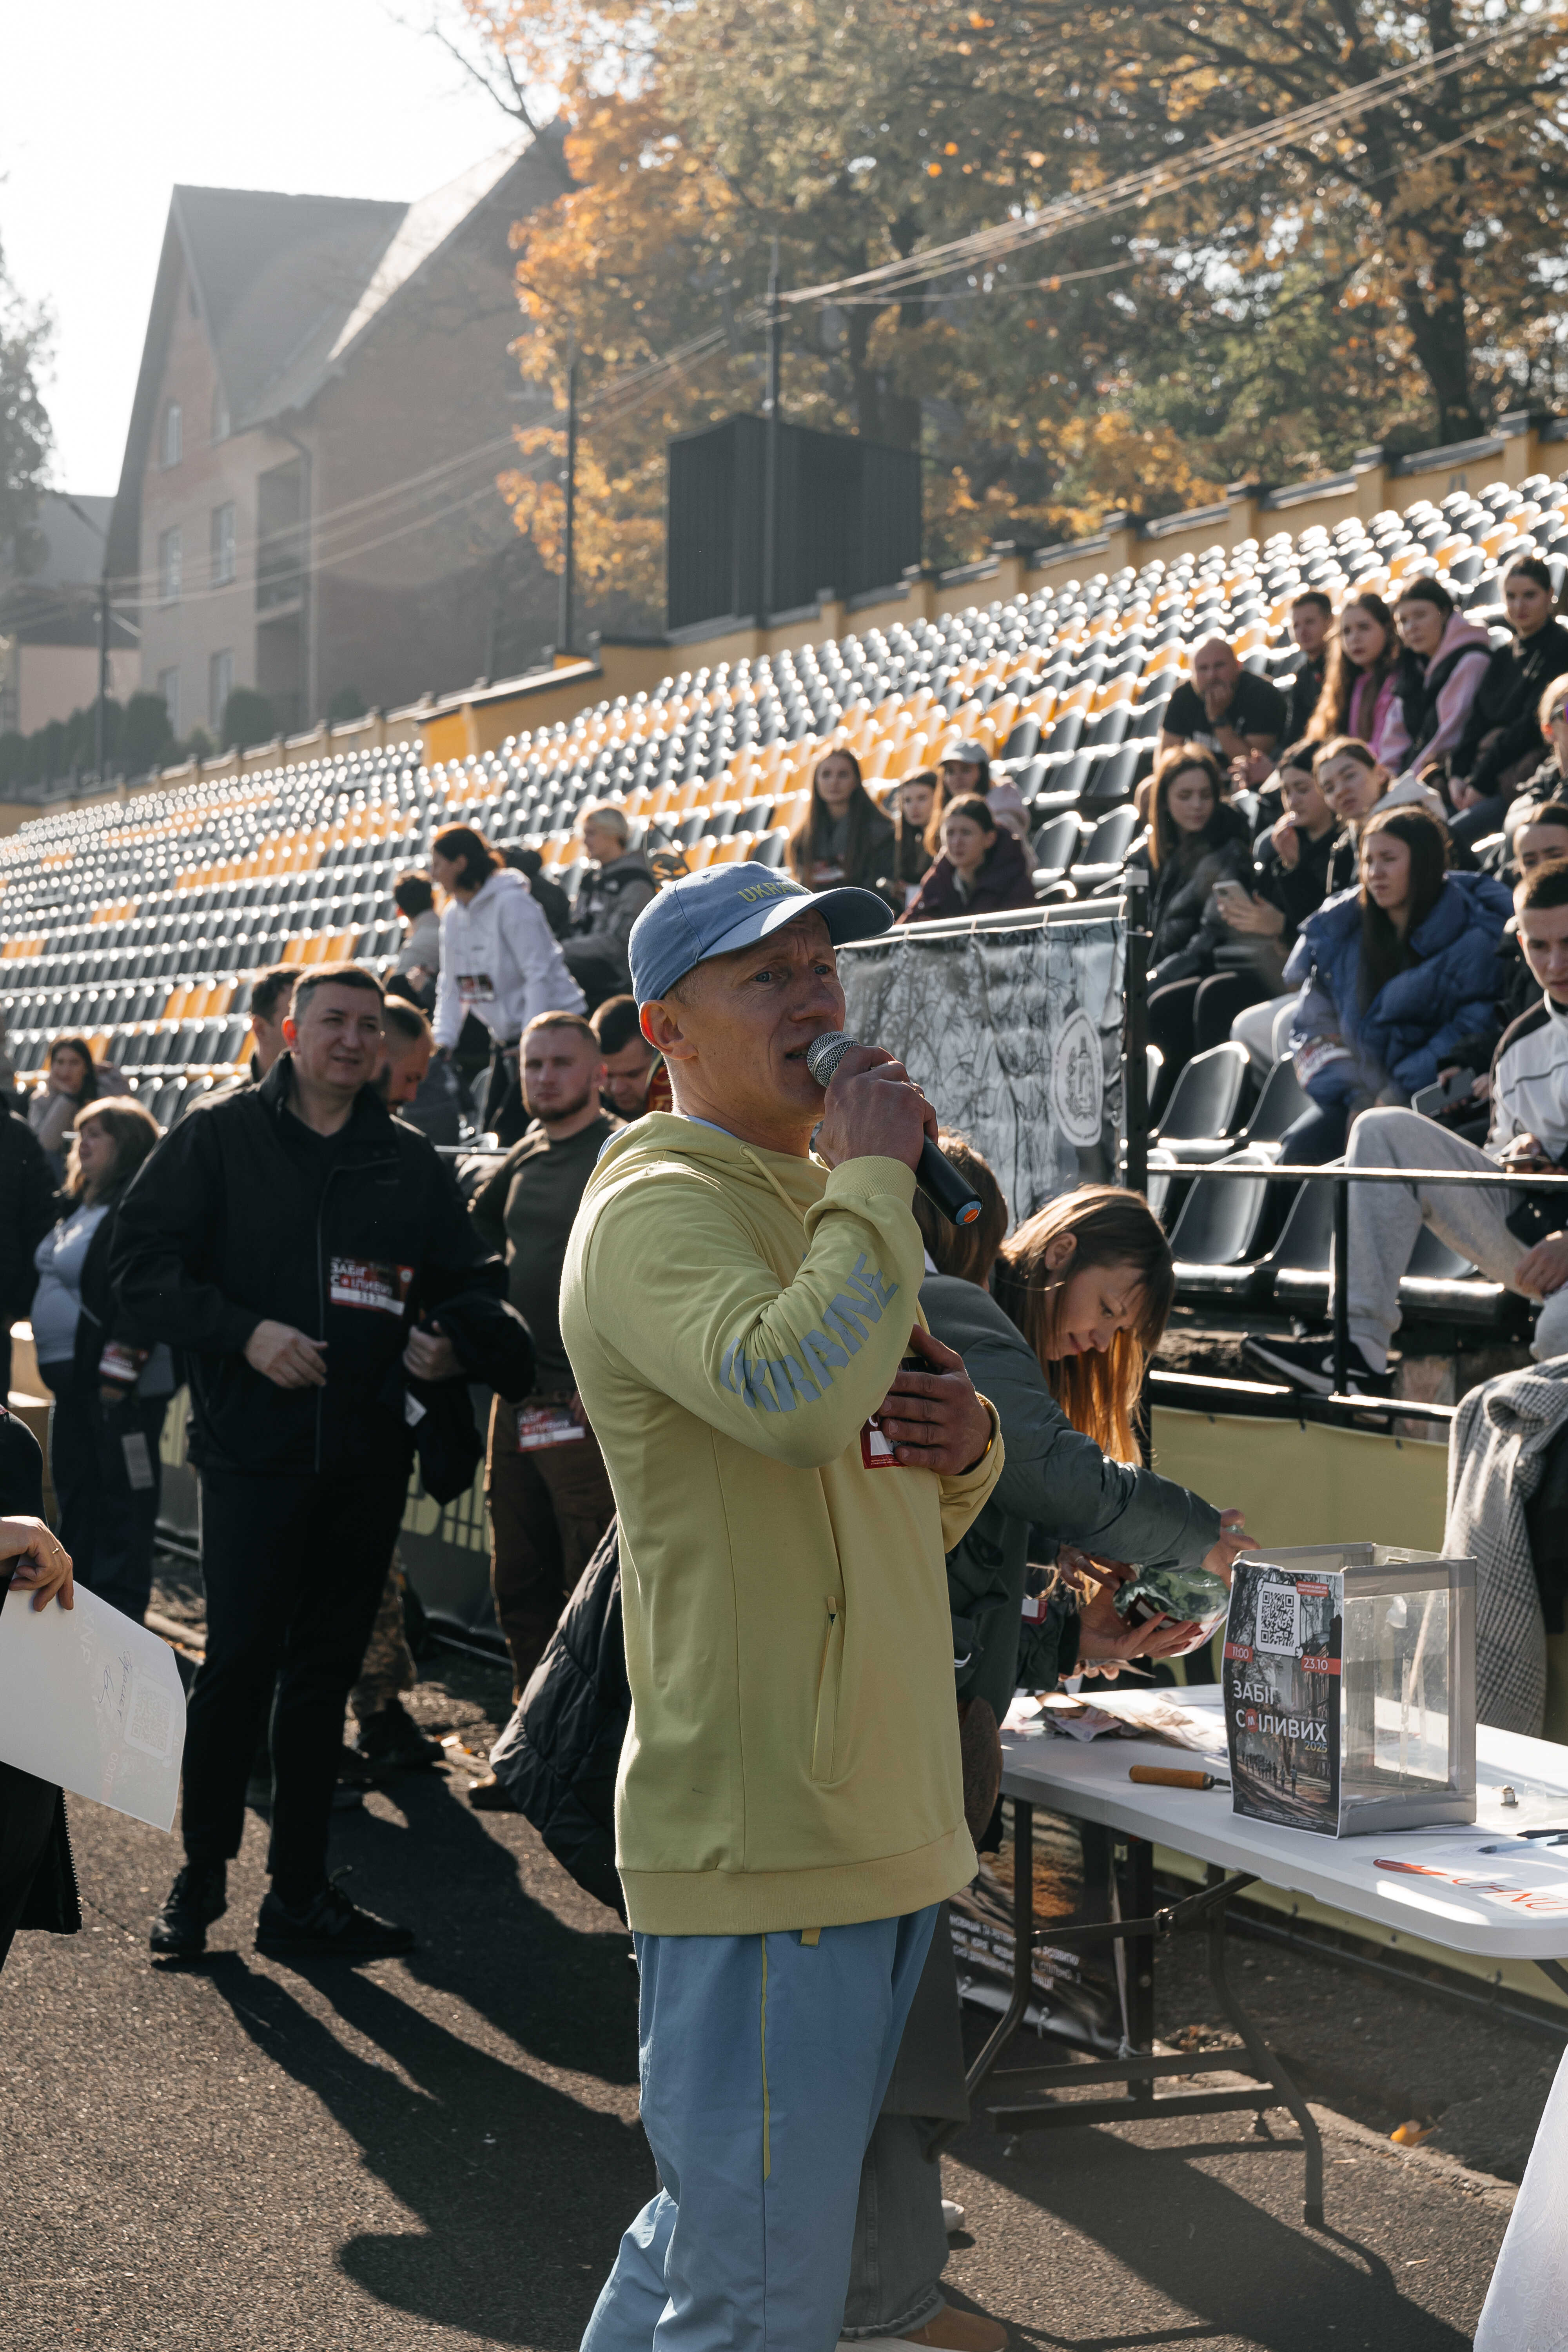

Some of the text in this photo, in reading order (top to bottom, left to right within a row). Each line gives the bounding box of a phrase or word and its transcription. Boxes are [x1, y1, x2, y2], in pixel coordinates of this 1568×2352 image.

[719, 1252, 898, 1412] UKRAINE
[1232, 1646, 1249, 1659] 11:00
[1303, 1657, 1328, 1671] 23.10
[1232, 1679, 1278, 1705] ЗАБІГ
[1235, 1709, 1327, 1742] СМІЛИВИХ
[1304, 1740, 1328, 1753] 2025
